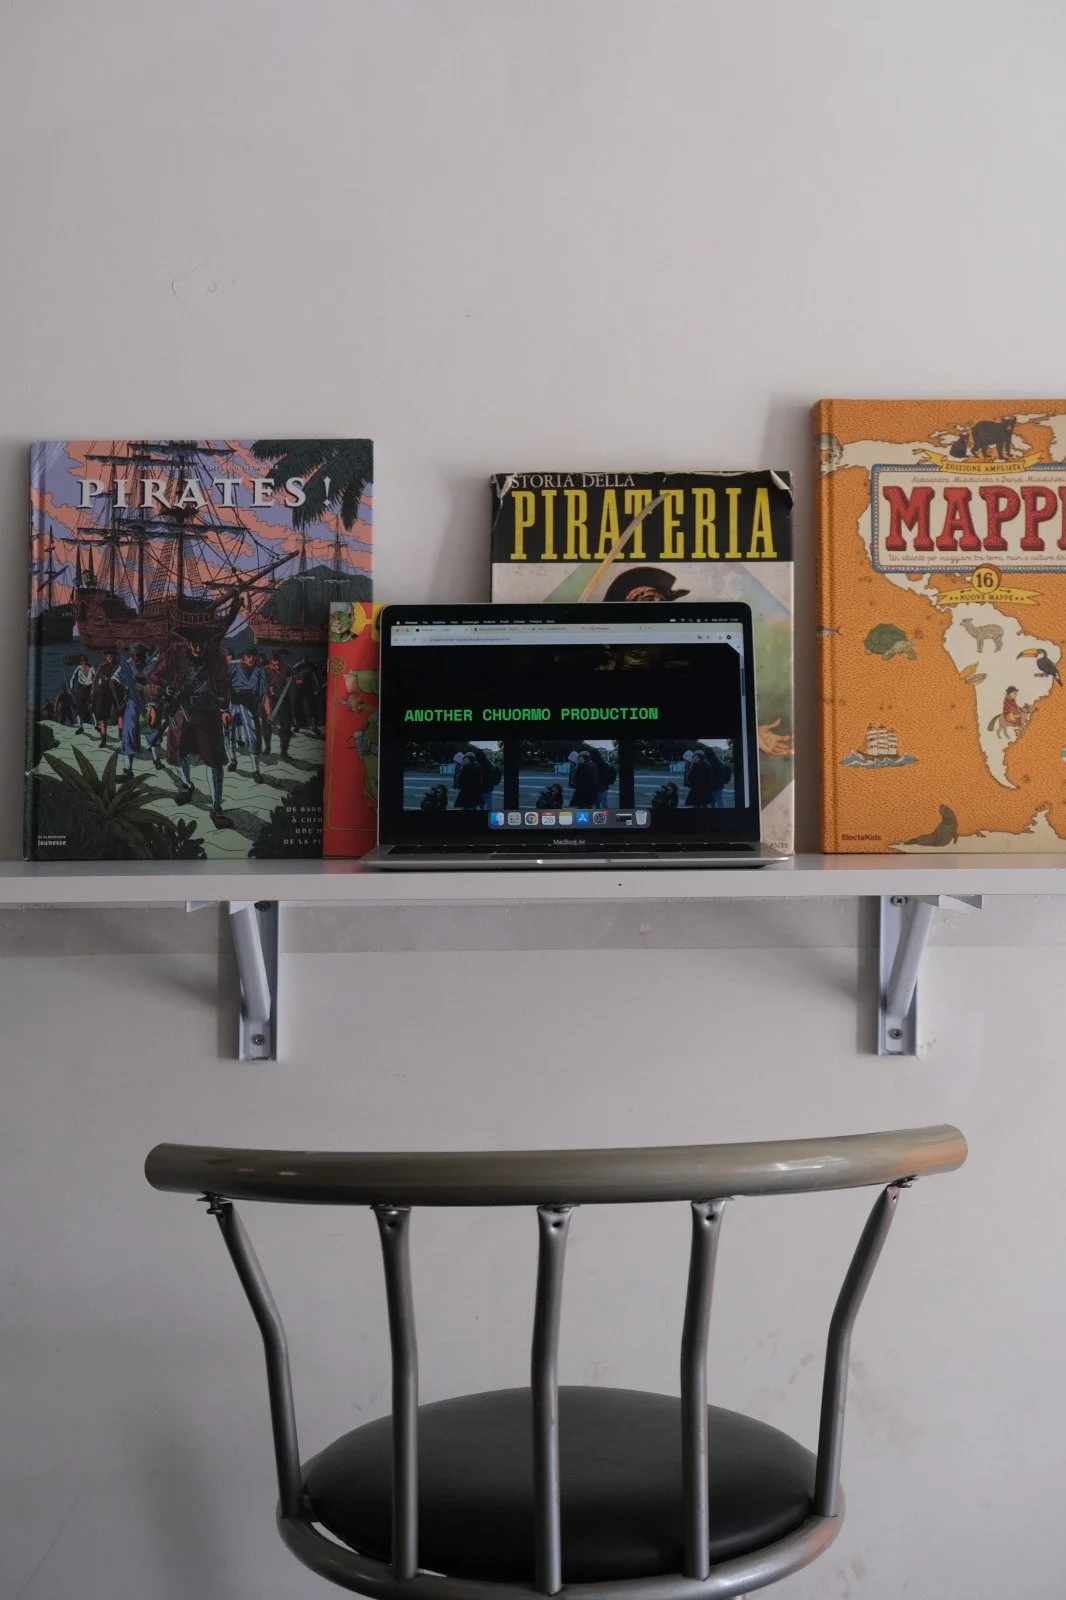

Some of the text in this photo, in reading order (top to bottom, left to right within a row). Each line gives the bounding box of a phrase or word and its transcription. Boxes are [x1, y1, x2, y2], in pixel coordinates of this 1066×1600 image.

[945, 463, 1021, 472] EDIZIONE AMPLIATA
[511, 474, 635, 489] STORIA DELLA
[76, 476, 307, 510] PIRATES
[510, 486, 778, 562] PIRATERIA
[976, 571, 994, 588] 16
[988, 594, 1014, 602] MAPPE
[404, 707, 659, 723] ANOTHER CHUORMO PRODUCTION
[543, 816, 555, 824] 28
[841, 833, 882, 841] ElectaKids
